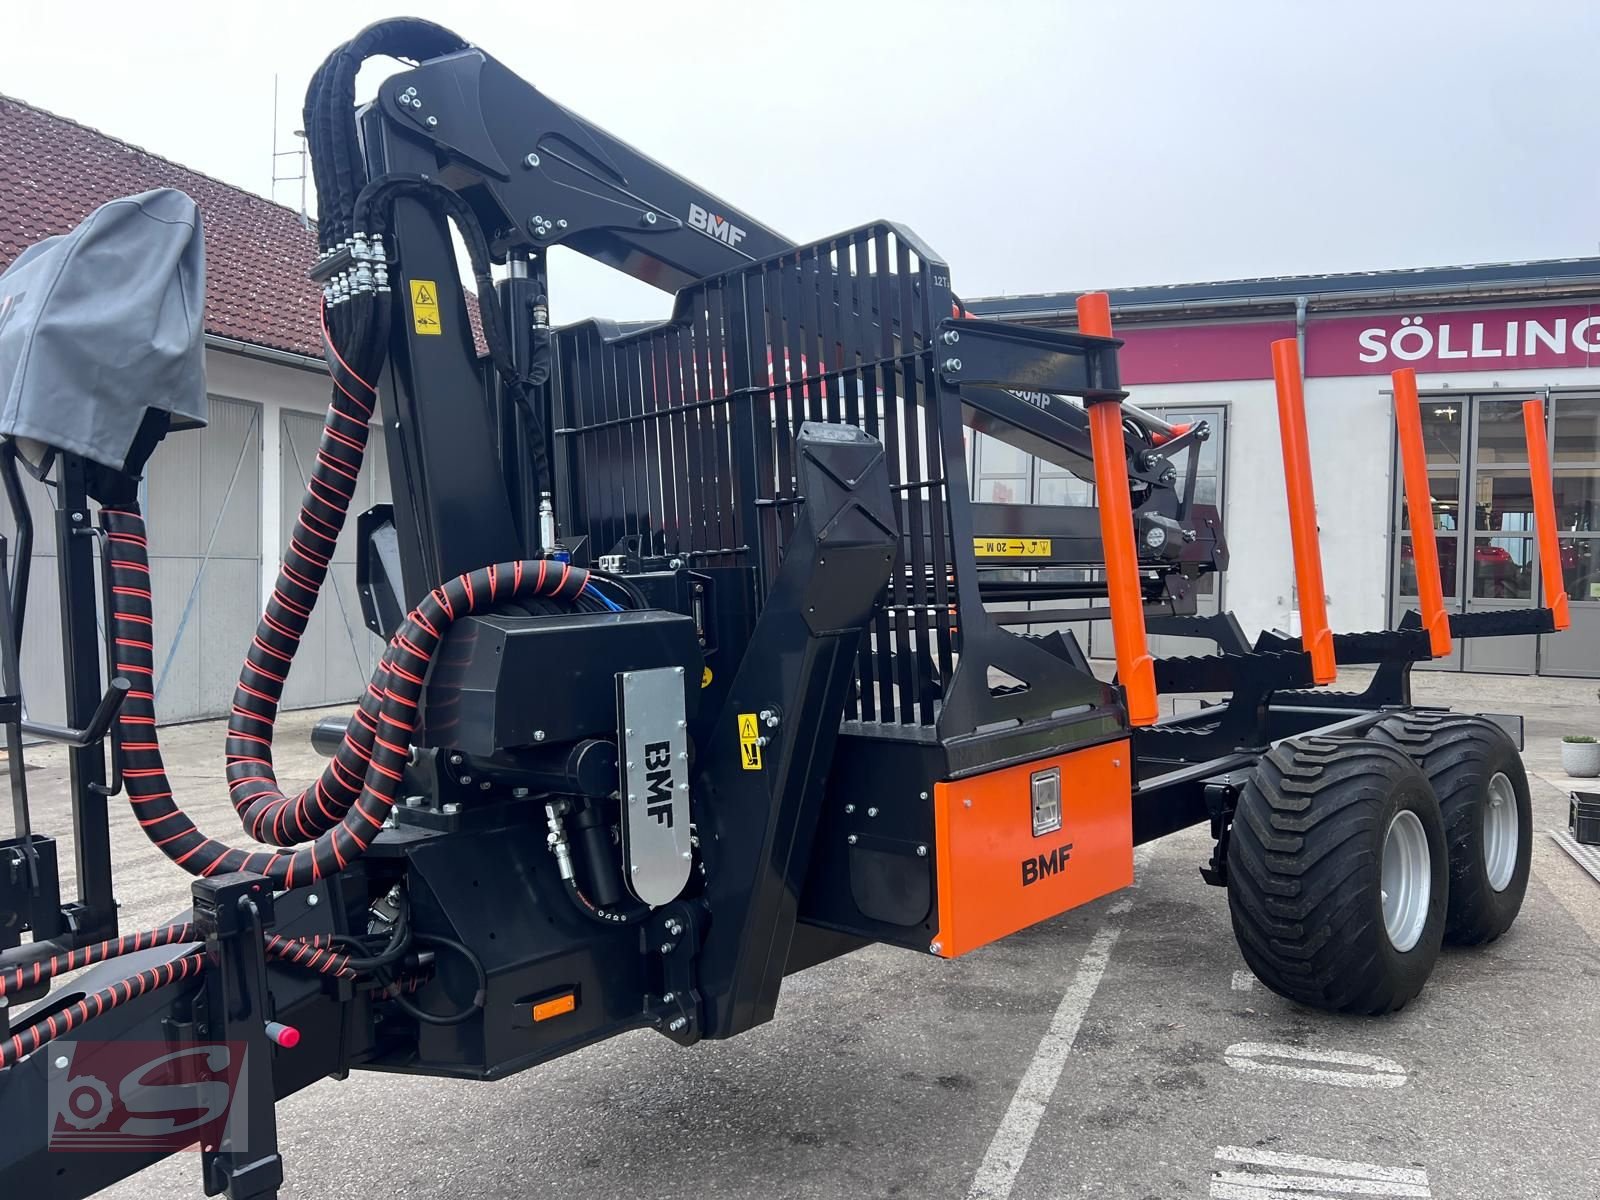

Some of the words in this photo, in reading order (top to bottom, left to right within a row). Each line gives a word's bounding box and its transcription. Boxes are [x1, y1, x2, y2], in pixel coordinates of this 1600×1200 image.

[688, 203, 746, 246] BMF
[1358, 316, 1600, 363] SÖLLING
[996, 542, 1007, 553] 20
[644, 740, 674, 829] BMF
[1021, 843, 1073, 887] BMF
